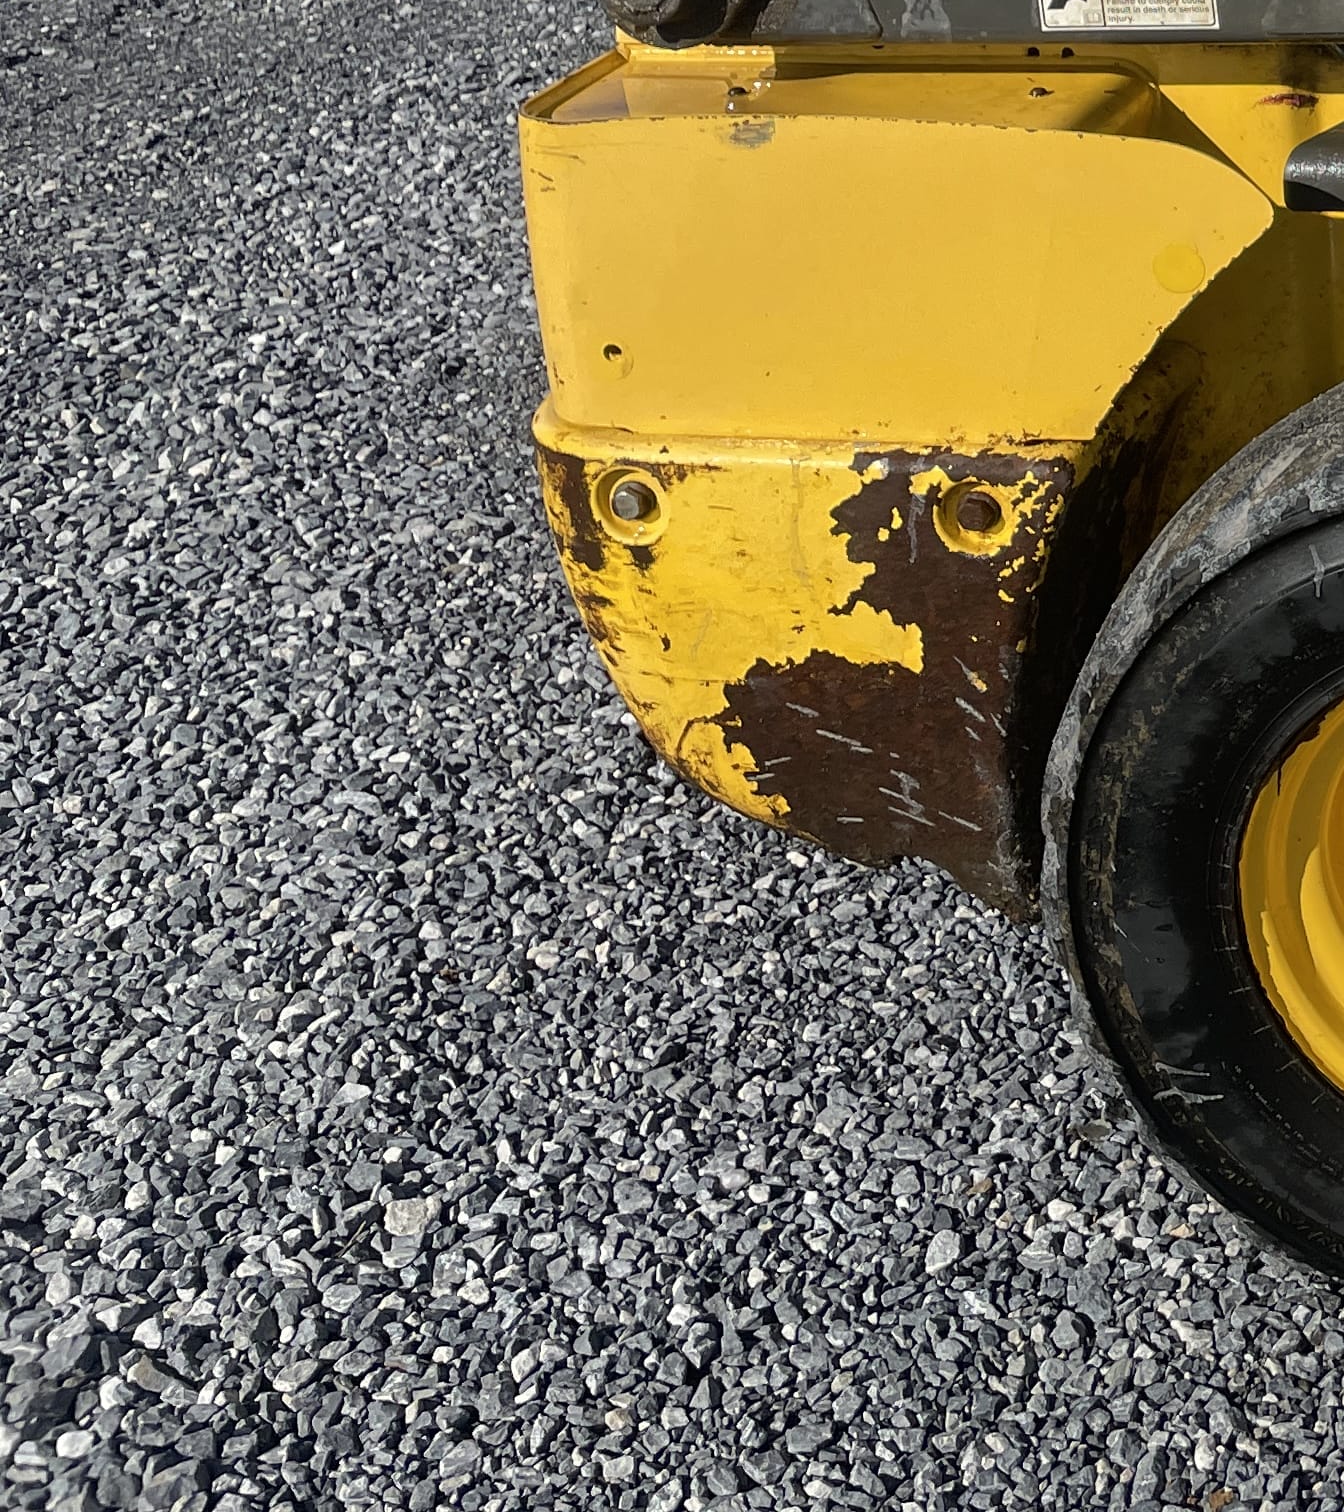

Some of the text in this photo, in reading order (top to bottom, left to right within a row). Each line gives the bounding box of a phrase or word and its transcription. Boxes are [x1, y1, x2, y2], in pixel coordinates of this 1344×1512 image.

[1107, 5, 1210, 14] result in death or serious
[1108, 15, 1135, 24] injury.
